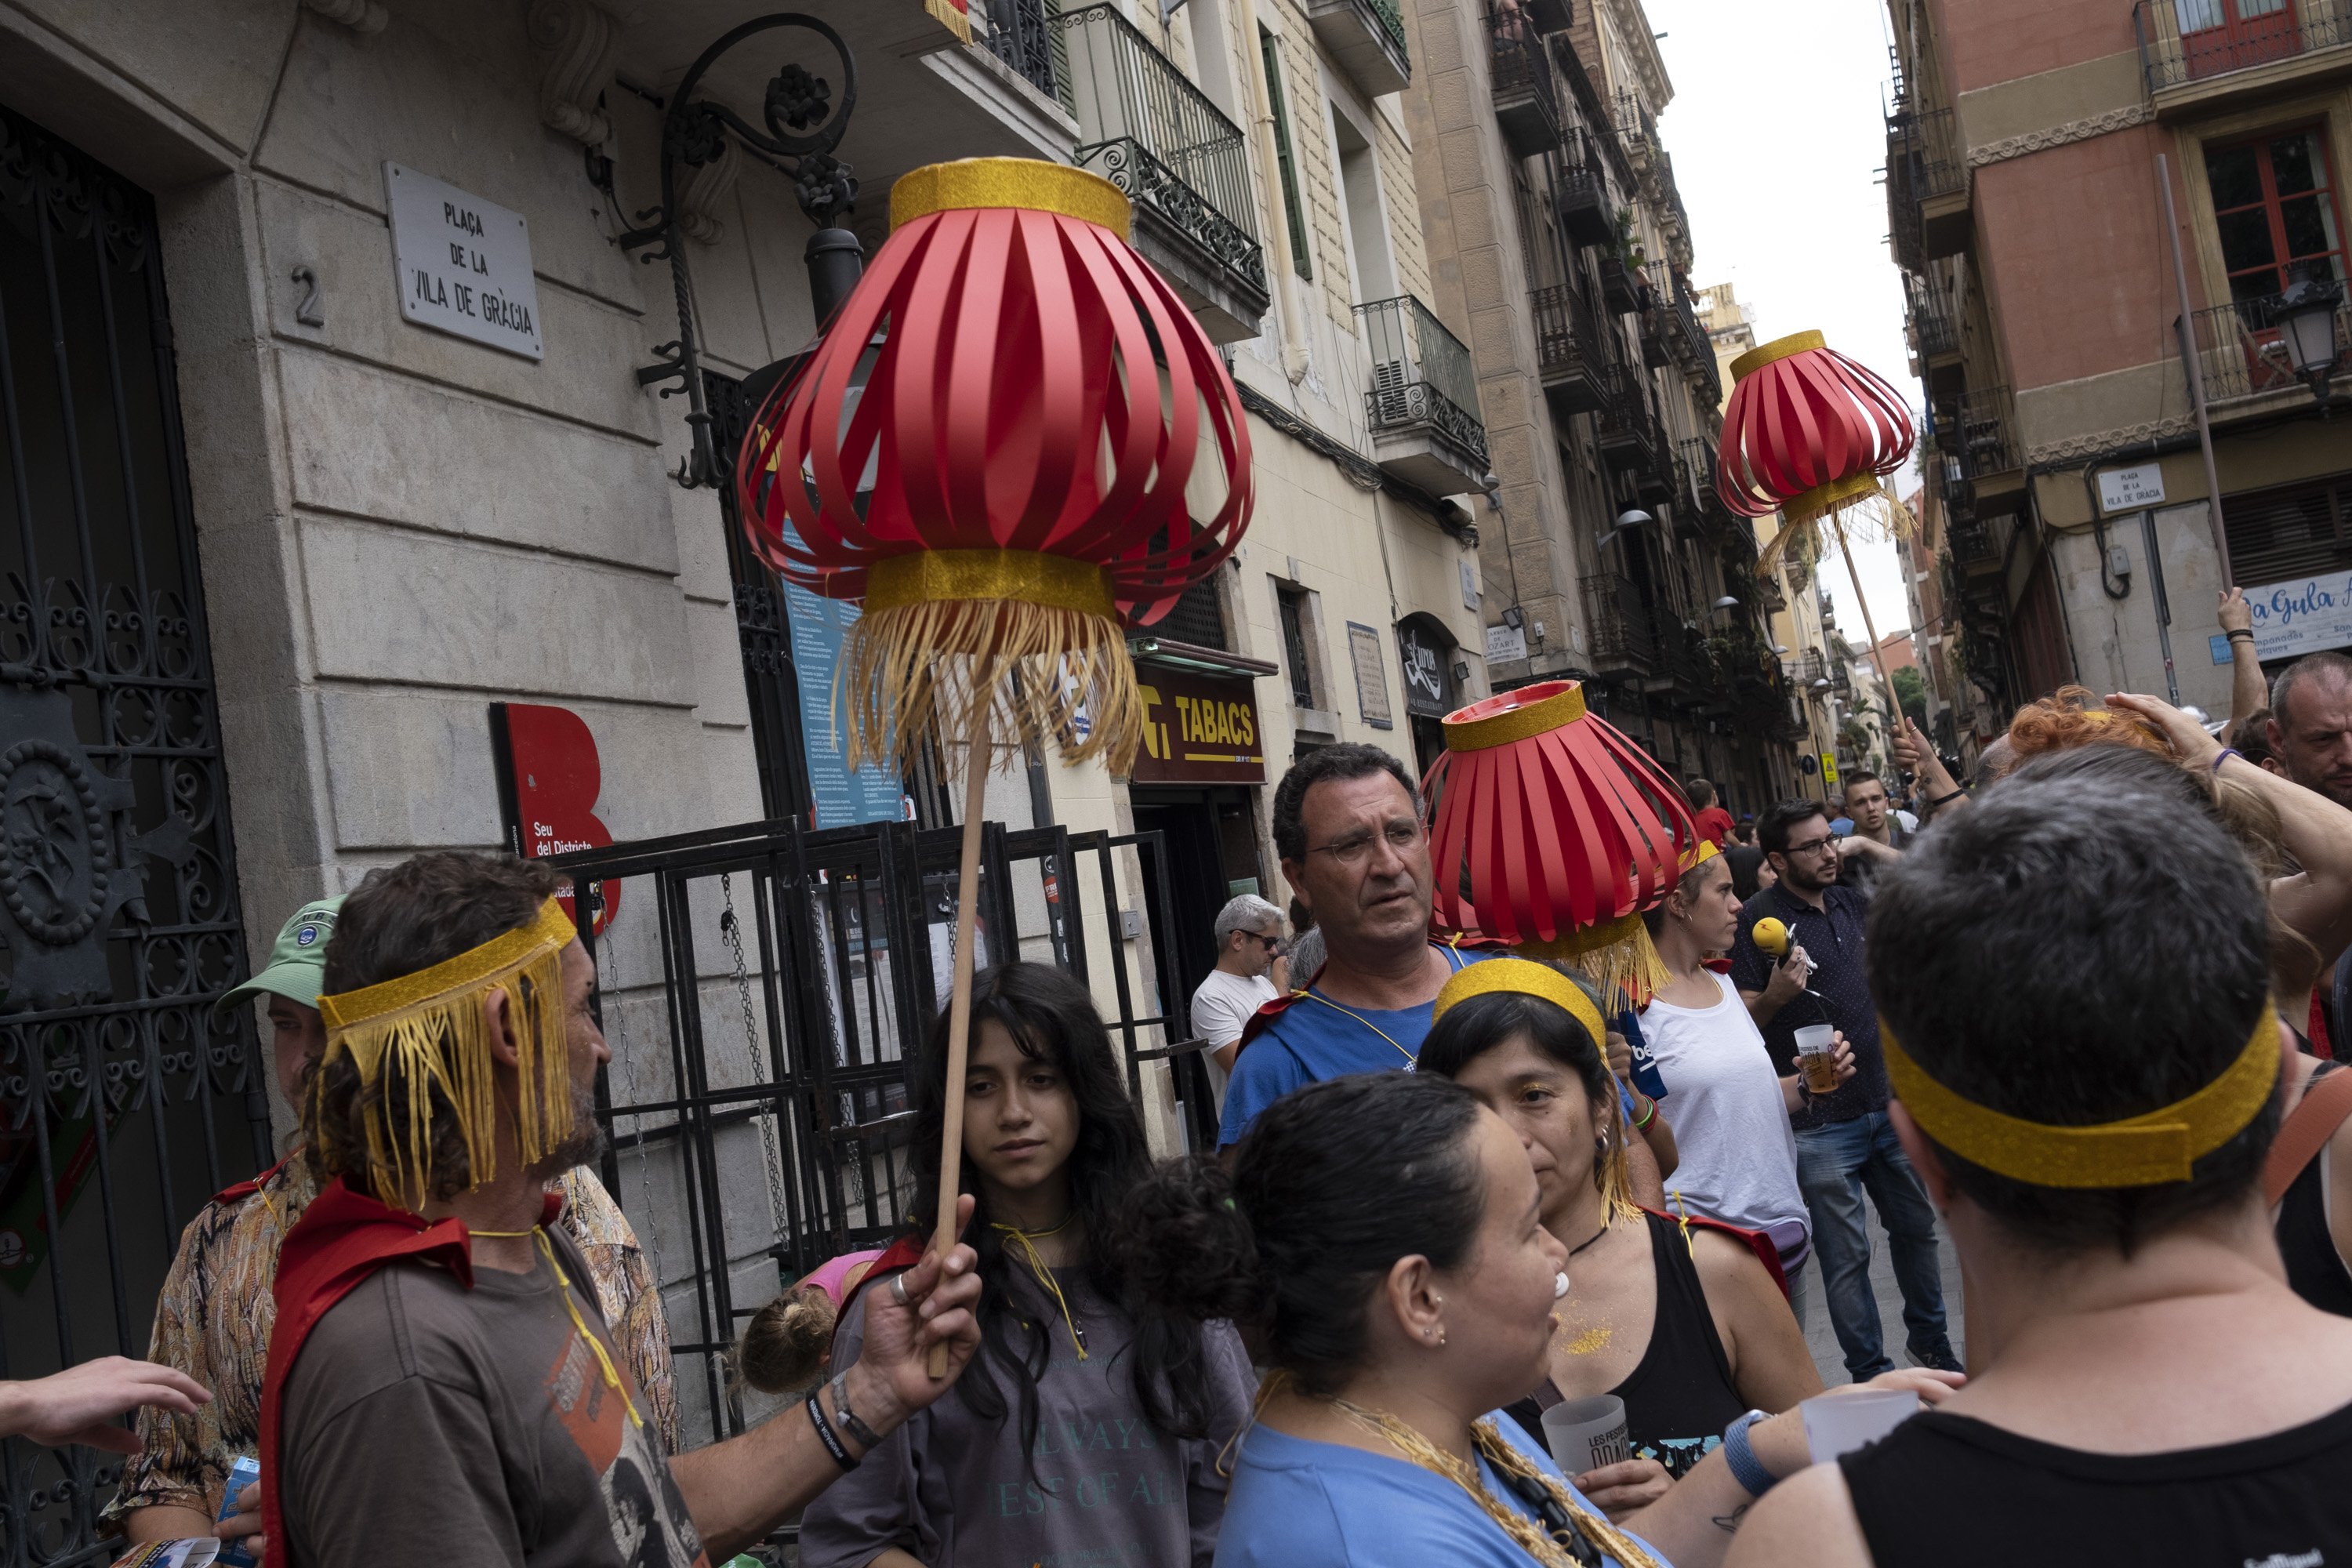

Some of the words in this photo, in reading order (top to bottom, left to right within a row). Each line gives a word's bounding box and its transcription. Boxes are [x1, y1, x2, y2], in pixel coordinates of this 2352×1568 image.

[444, 201, 484, 237] PLAÇA
[450, 242, 466, 268] DE
[471, 250, 488, 276] LA
[291, 263, 325, 328] 2
[412, 268, 449, 309] VILA
[455, 282, 476, 318] DE
[481, 287, 534, 336] GRÀCIA
[2106, 495, 2122, 506] VILA
[2243, 597, 2270, 627] a
[2271, 582, 2335, 625] Gula
[1487, 639, 1515, 650] OZART
[1175, 695, 1254, 746] TABACS
[534, 822, 553, 837] Seu
[537, 840, 552, 857] del
[1588, 1433, 1606, 1448] LES
[1076, 1472, 1119, 1510] OF
